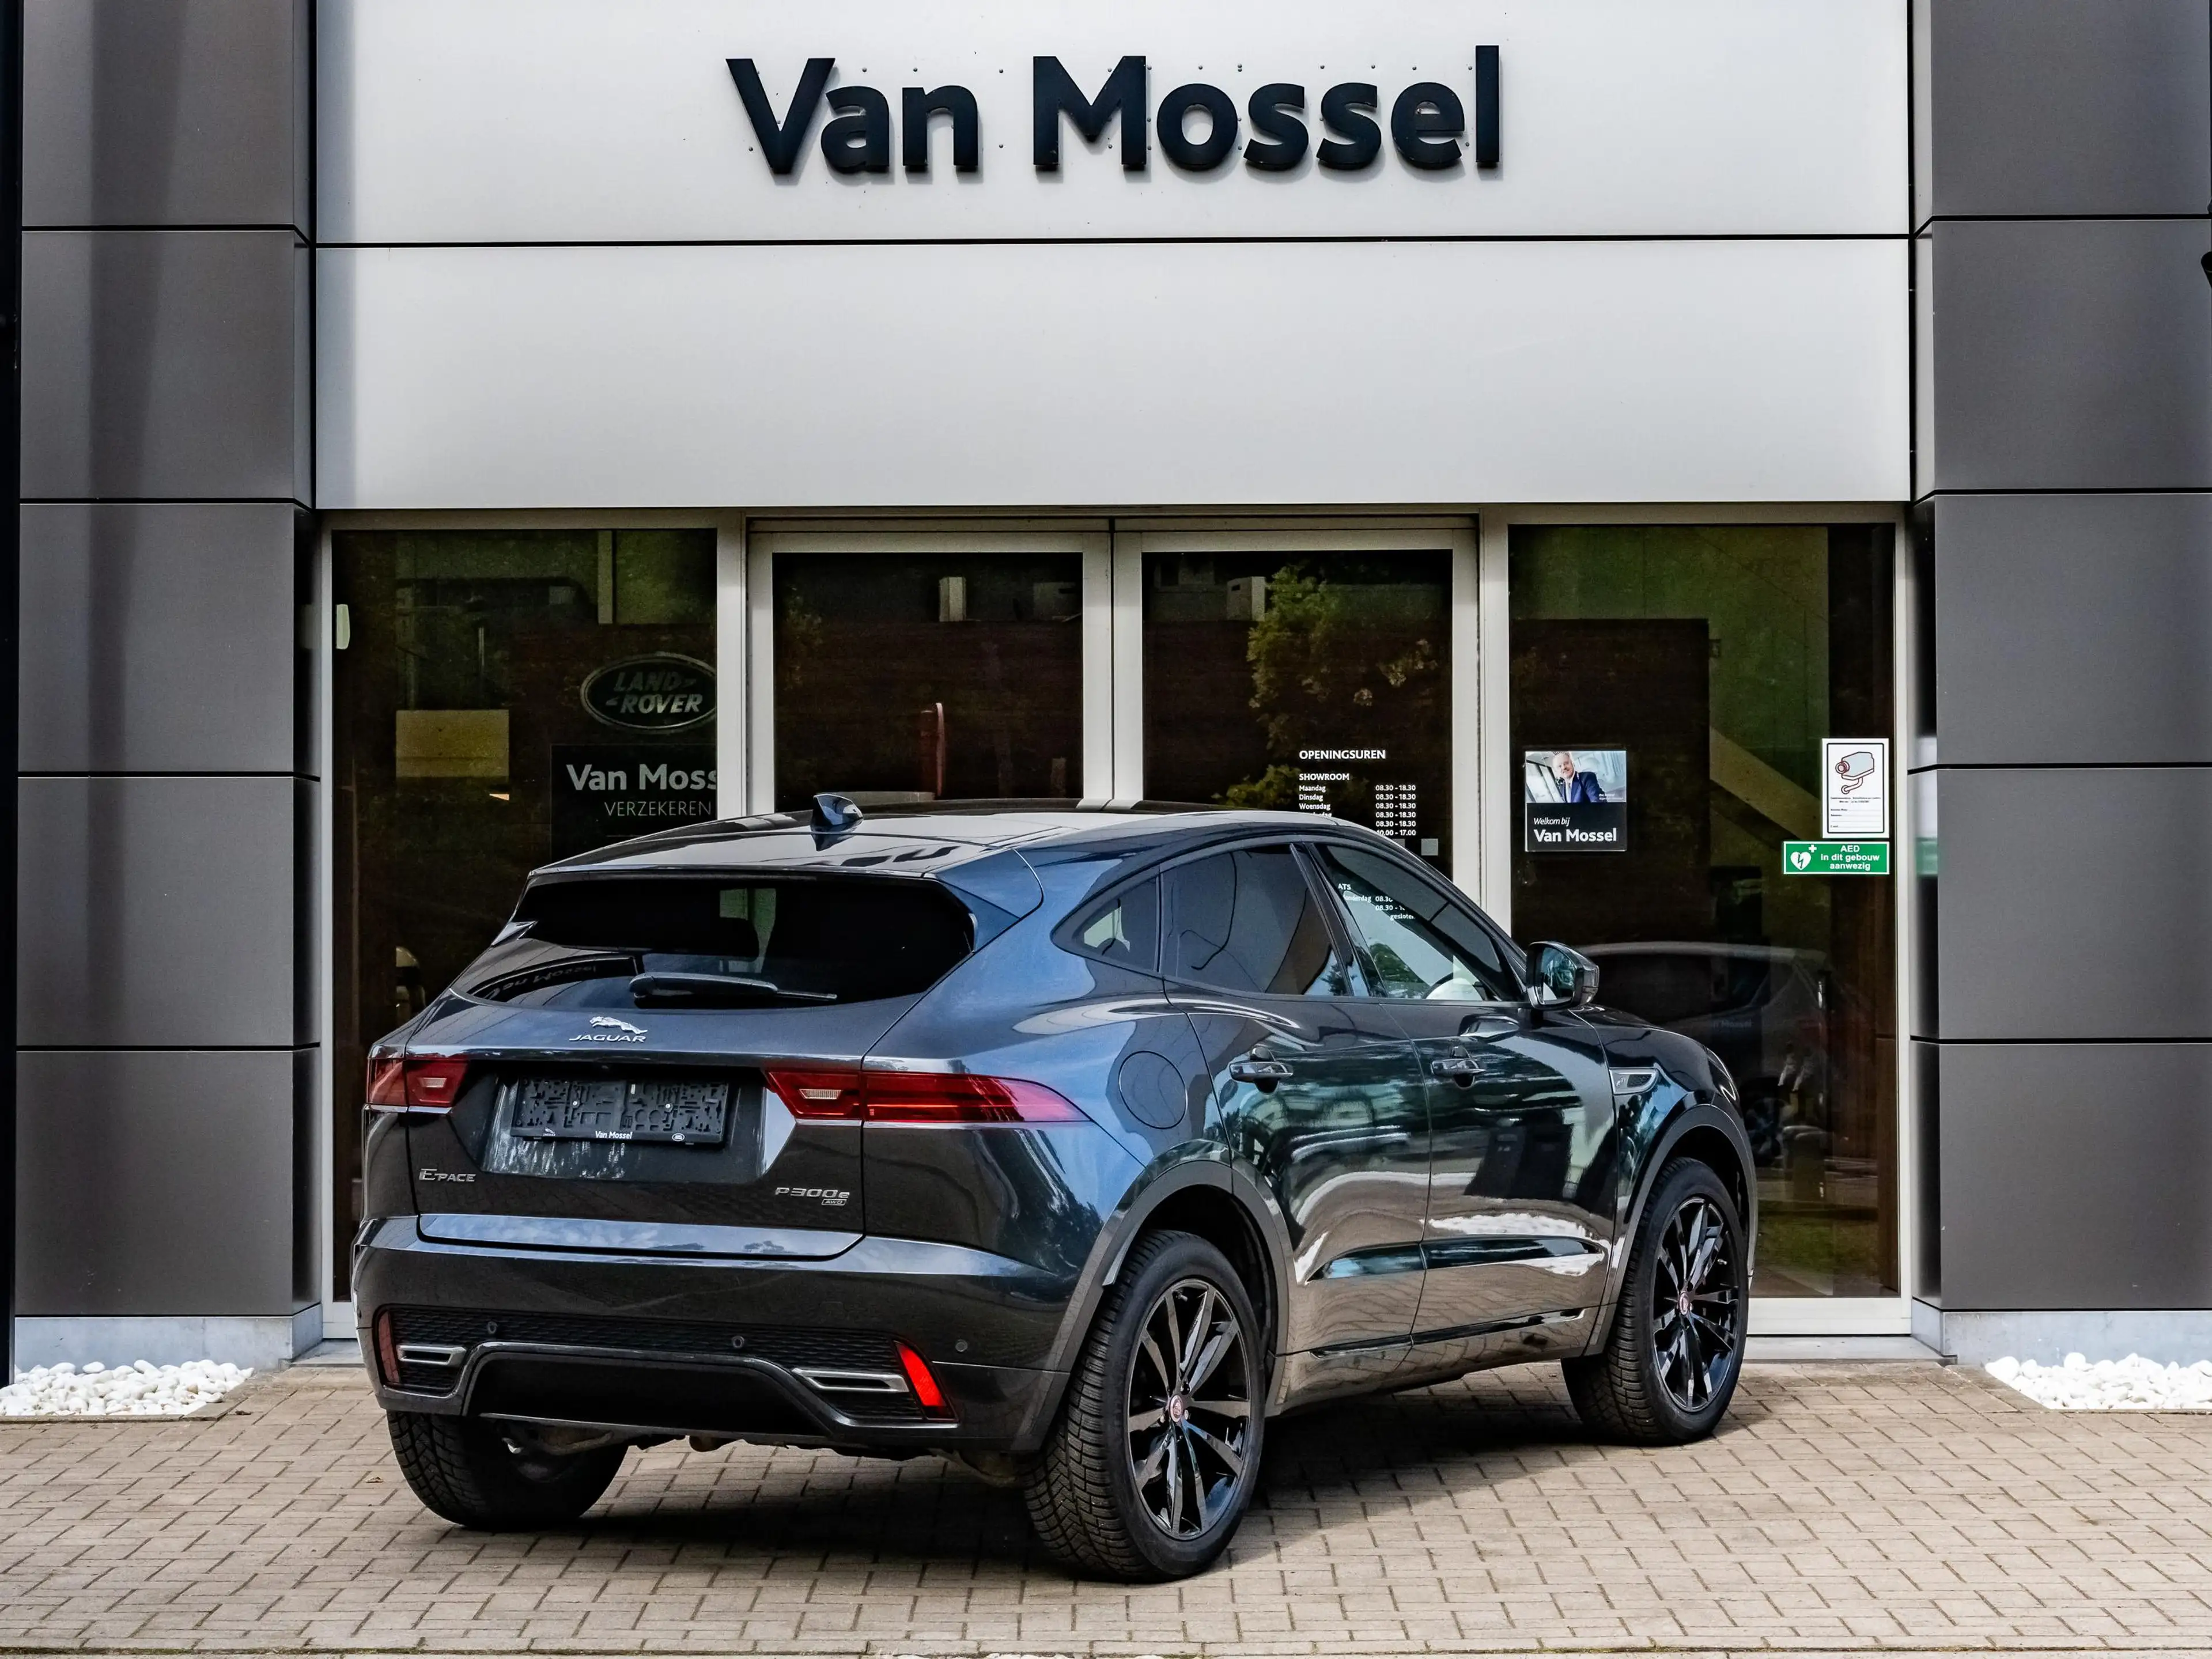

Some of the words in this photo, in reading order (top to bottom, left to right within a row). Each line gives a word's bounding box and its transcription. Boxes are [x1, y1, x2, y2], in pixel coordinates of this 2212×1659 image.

[725, 56, 979, 175] Van
[1033, 45, 1500, 173] Mossel
[613, 671, 686, 691] LAND
[620, 693, 704, 714] ROVER
[1299, 749, 1386, 760] OPENINGSUREN
[566, 763, 627, 790] Van
[639, 763, 717, 790] Moss
[1299, 773, 1350, 781] SHOWROOM
[1299, 785, 1326, 793] Maandag
[1299, 794, 1324, 802] Dinsdag
[604, 800, 711, 816] VERZEKEREN
[1299, 803, 1331, 811] Woensdag
[1533, 817, 1560, 825] Welkom
[1561, 817, 1570, 827] bij
[1533, 828, 1561, 842] Van
[1566, 828, 1617, 842] Mossel
[1840, 844, 1860, 853] AED
[1845, 853, 1880, 862] gebouw
[1829, 862, 1871, 871] aanwezig
[569, 1034, 646, 1043] JAGUAR
[595, 1131, 608, 1139] Van
[608, 1131, 633, 1139] Mossel
[774, 1187, 850, 1198] P300e
